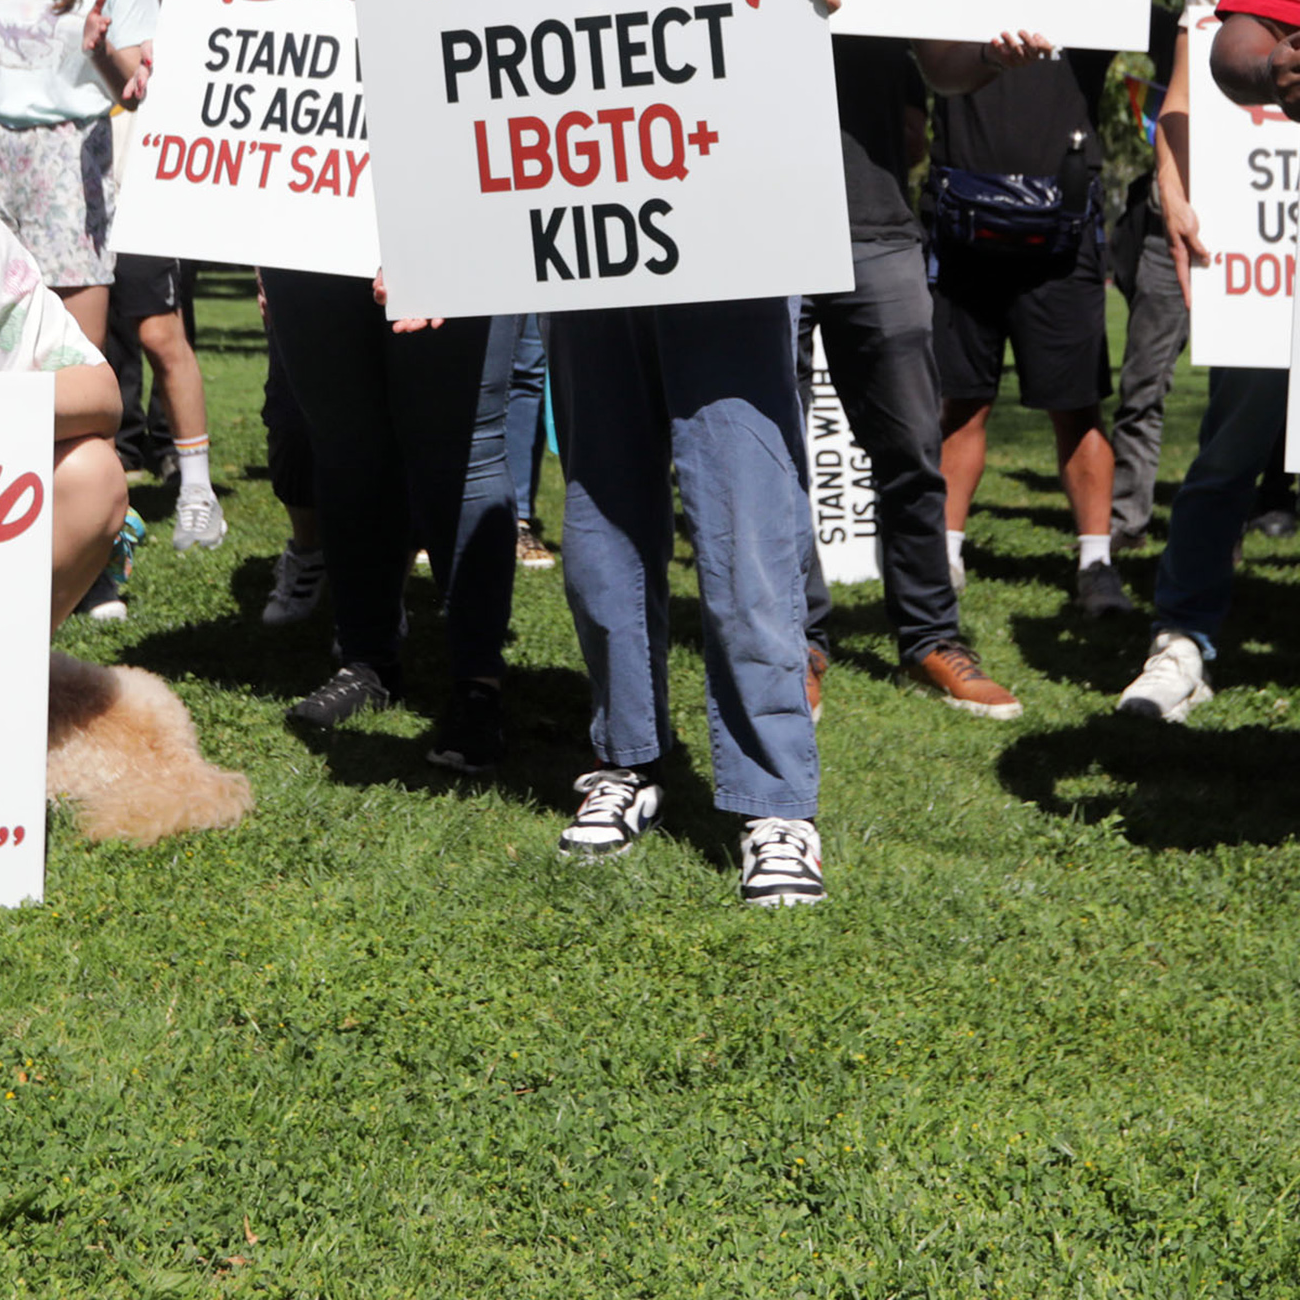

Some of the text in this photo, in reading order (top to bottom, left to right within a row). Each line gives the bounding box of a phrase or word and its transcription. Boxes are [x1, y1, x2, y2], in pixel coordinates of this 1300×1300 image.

[205, 27, 340, 79] STAND
[441, 3, 734, 104] PROTECT
[202, 82, 367, 140] US AGAI
[474, 103, 719, 193] LBGTQ+
[142, 133, 370, 198] "DON'T SAY
[529, 198, 679, 282] KIDS
[817, 449, 846, 546] STAND
[852, 501, 879, 538] US
